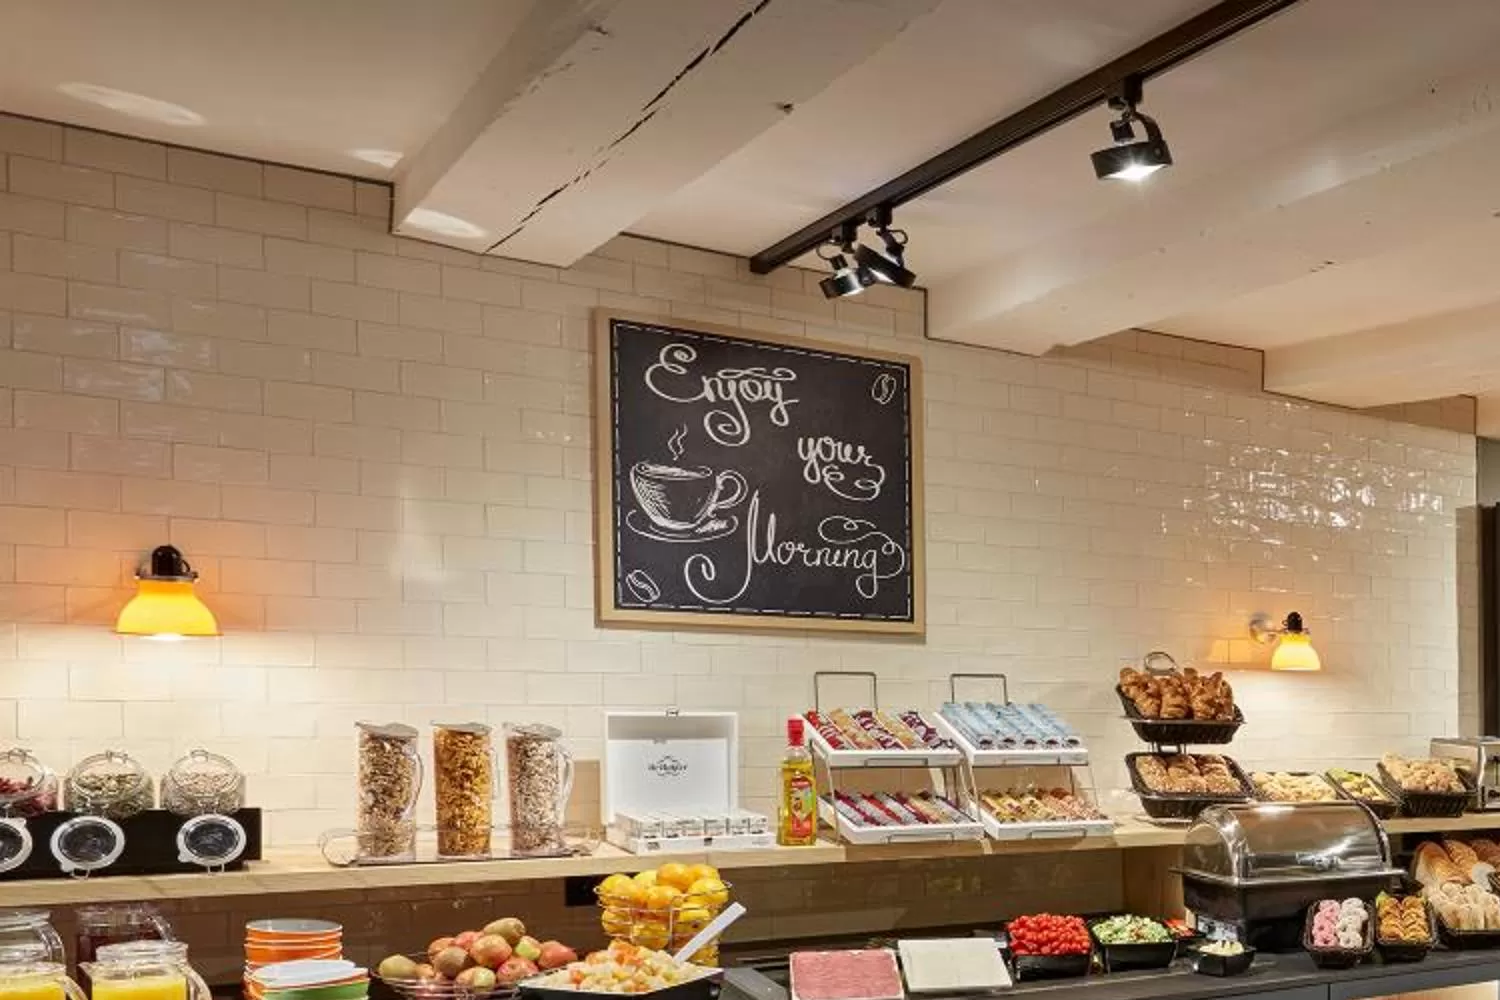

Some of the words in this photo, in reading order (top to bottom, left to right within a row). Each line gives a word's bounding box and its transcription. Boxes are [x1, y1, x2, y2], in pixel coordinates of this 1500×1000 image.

[645, 343, 799, 446] Enjoy
[797, 436, 885, 500] your
[684, 490, 905, 603] Morning
